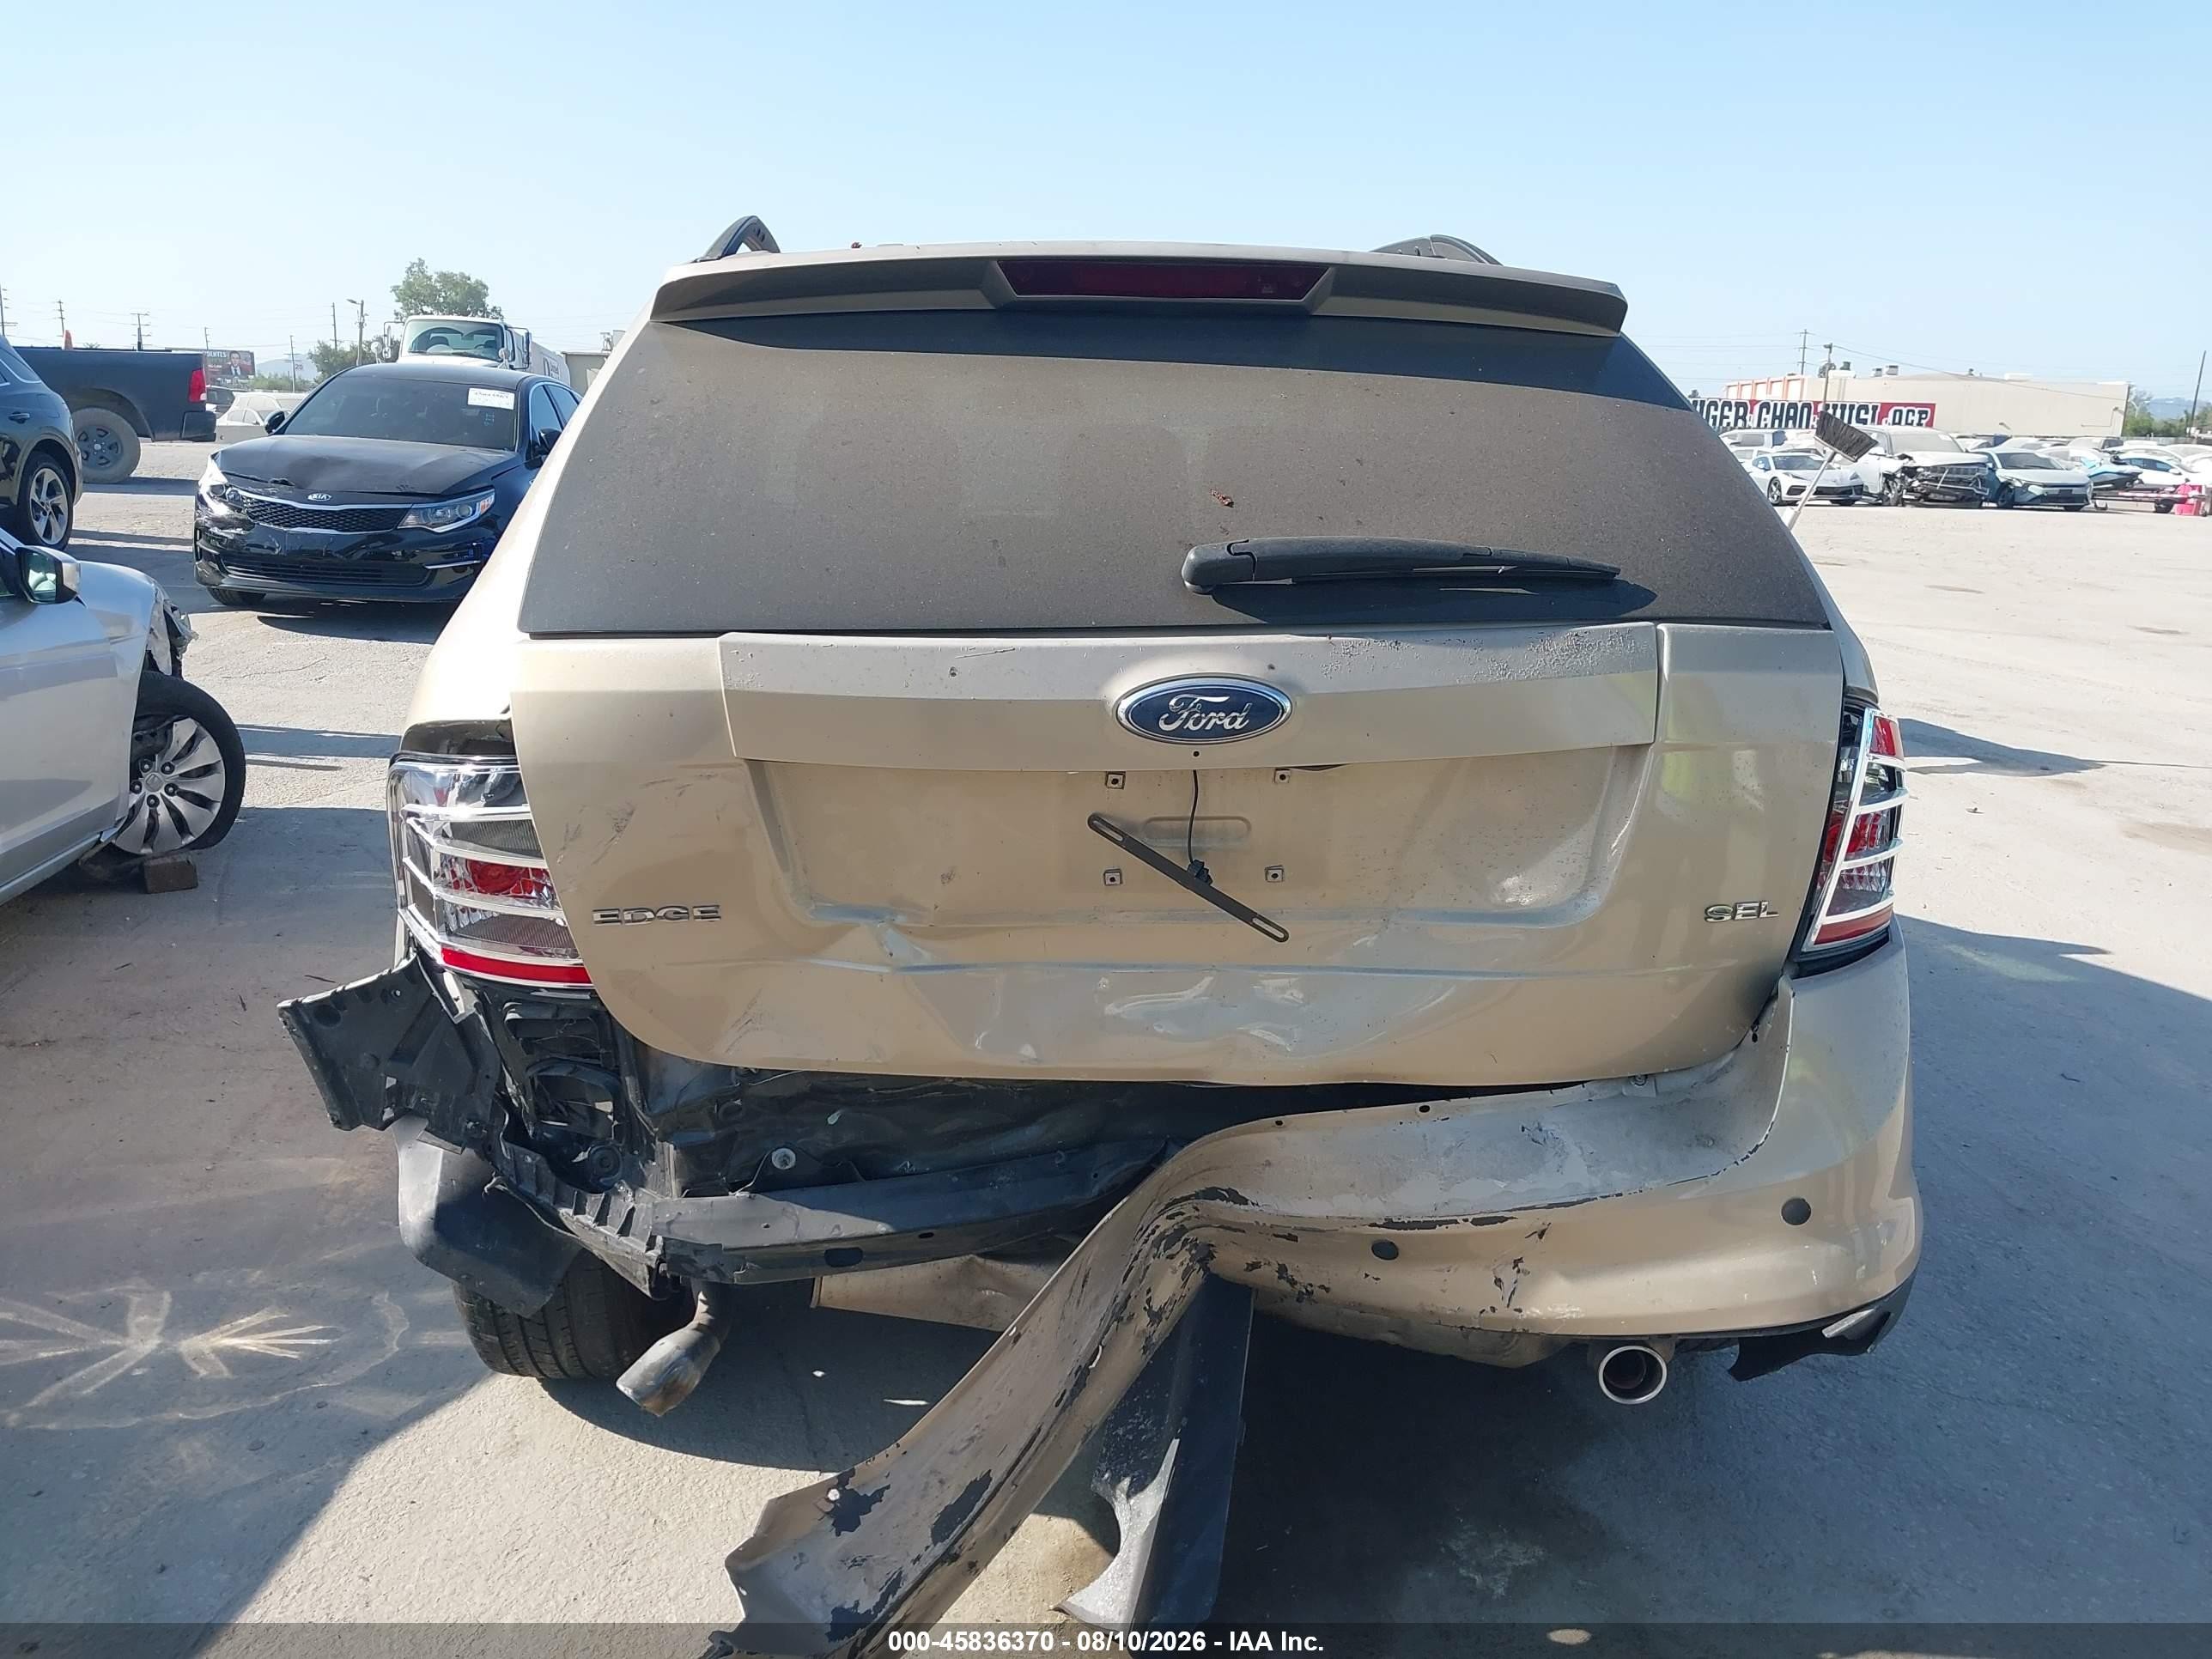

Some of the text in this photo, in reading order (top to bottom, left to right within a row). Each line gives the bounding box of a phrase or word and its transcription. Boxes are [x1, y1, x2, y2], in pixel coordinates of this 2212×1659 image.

[1158, 694, 1253, 731] Ford
[592, 904, 722, 926] EDGE
[1705, 900, 1780, 922] SEL
